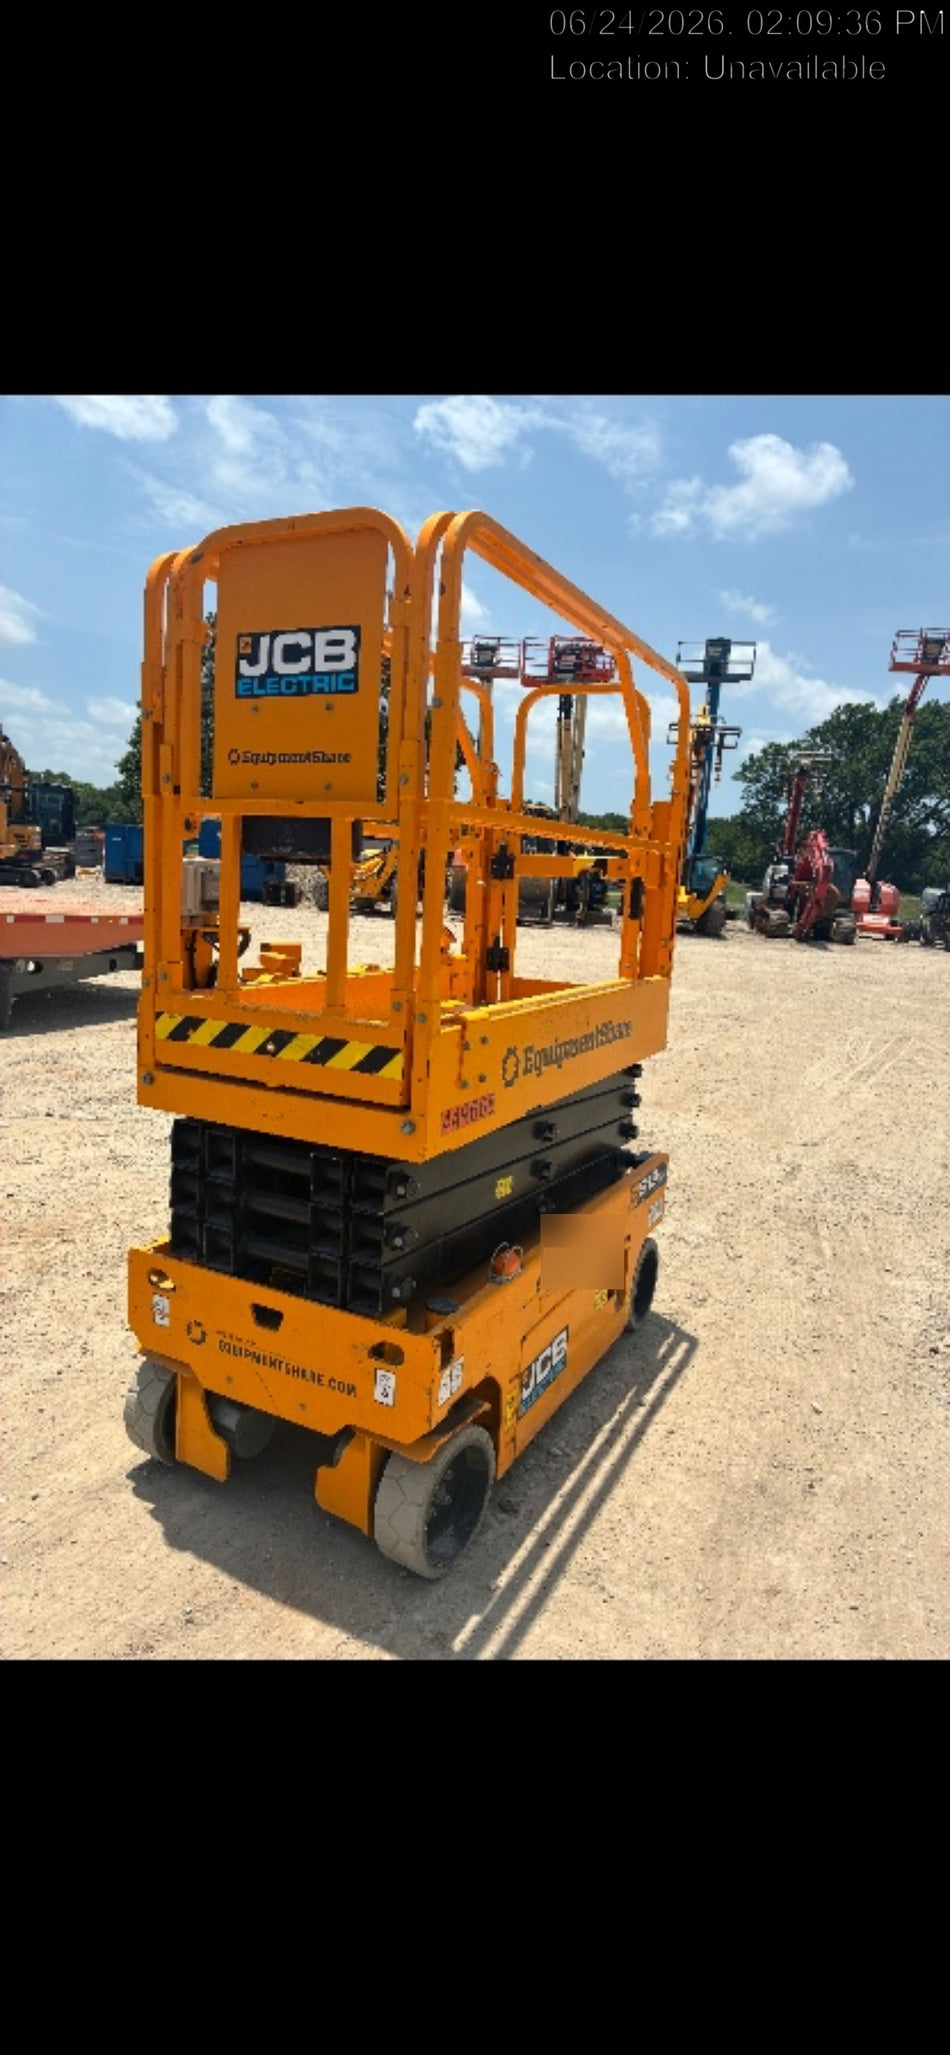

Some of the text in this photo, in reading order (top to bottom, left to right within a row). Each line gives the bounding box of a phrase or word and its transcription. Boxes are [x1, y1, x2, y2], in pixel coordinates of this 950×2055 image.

[239, 629, 357, 677] JCB
[237, 673, 354, 695] ELECTRIC
[242, 751, 351, 765] EquipmentShare
[522, 1329, 567, 1400] JCB
